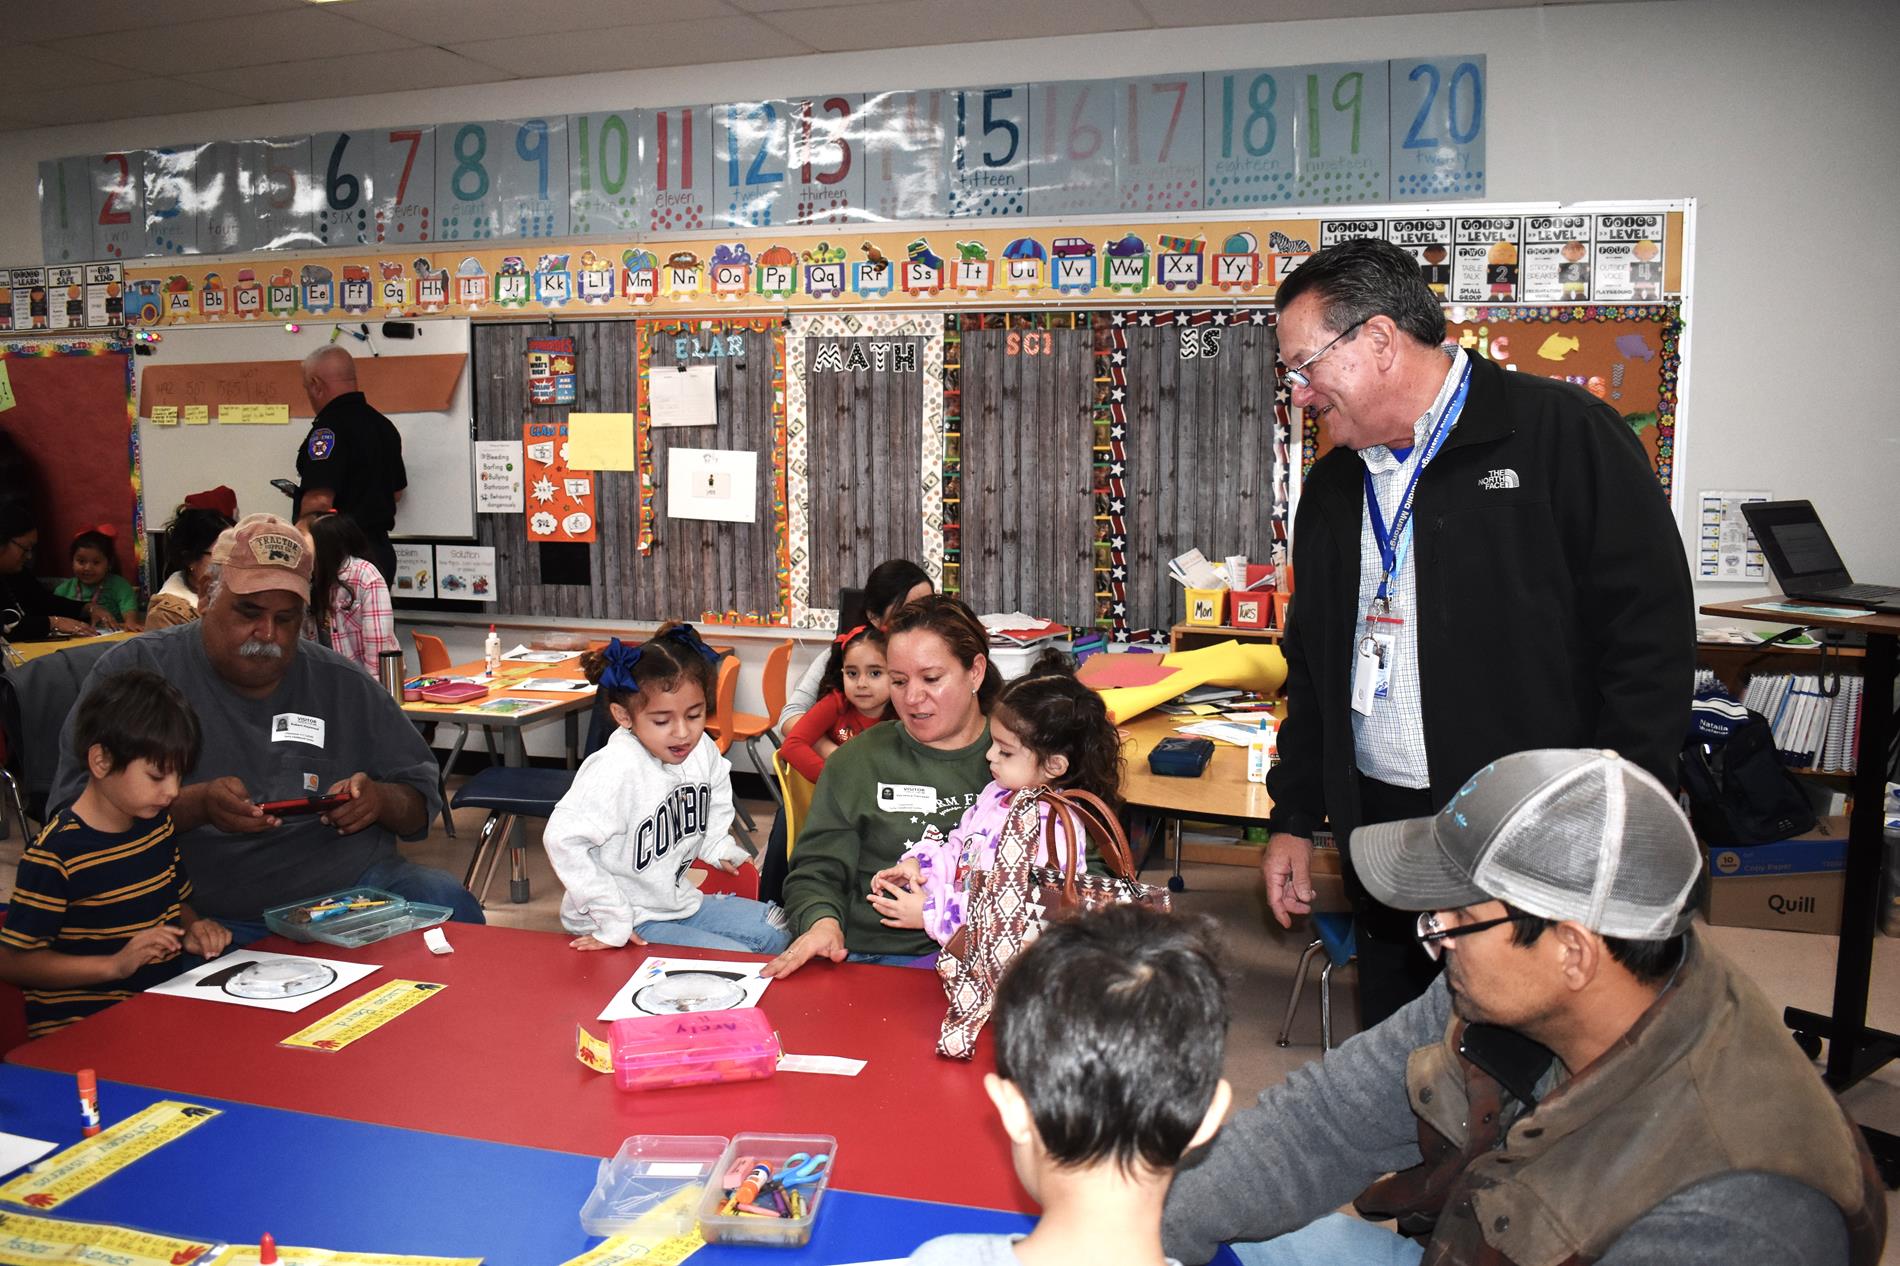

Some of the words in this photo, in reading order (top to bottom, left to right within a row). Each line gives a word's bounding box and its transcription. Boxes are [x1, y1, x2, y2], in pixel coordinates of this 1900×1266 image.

[1403, 63, 1482, 149] 20
[1222, 73, 1277, 157] 18
[1307, 72, 1363, 157] 19
[957, 89, 1019, 169] 15
[1045, 86, 1104, 160] 16
[1129, 82, 1187, 164] 17
[728, 103, 783, 186] 12
[800, 98, 851, 184] 13
[579, 115, 629, 195] 10
[657, 111, 692, 190] 11
[390, 130, 421, 205] 7
[452, 124, 490, 200] 8
[516, 119, 548, 200] 9
[326, 133, 359, 210] 6
[960, 173, 1014, 187] fifteen
[99, 154, 131, 224] 2
[800, 187, 847, 200] thirteen
[656, 193, 695, 208] eleven
[331, 211, 353, 224] six
[389, 204, 421, 217] even
[1401, 232, 1438, 243] LEVEL
[1467, 231, 1506, 242] LEVEL
[1538, 230, 1577, 240] LEVEL
[1610, 229, 1649, 240] LEVEL
[1459, 249, 1486, 257] TWO
[1599, 246, 1630, 254] FOUR
[912, 264, 931, 280] Ss
[962, 262, 981, 278] Tt
[1010, 261, 1034, 278] Uu
[1061, 260, 1084, 277] Vv
[1111, 259, 1143, 276] Ww
[1168, 256, 1193, 273] Xx
[1222, 257, 1246, 281] Yy
[1462, 264, 1483, 272] TABLE
[1638, 263, 1651, 281] 4
[57, 277, 74, 285] SAFE
[95, 274, 114, 282] KIND
[589, 271, 604, 287] Ll
[627, 271, 652, 287] Mm
[673, 270, 696, 284] Nn
[718, 268, 742, 283] Oo
[766, 267, 786, 289] Pp
[812, 267, 838, 288] Qq
[861, 265, 882, 281] Rr
[1495, 266, 1508, 282] 2
[1568, 265, 1580, 281] 3
[18, 279, 39, 287] LEARN
[349, 284, 363, 298] Ff
[421, 281, 442, 296] Hh
[467, 279, 479, 293] Ii
[504, 278, 520, 297] Jj
[545, 275, 564, 291] Kk
[205, 292, 222, 306] Bb
[239, 292, 257, 305] Cc
[274, 288, 292, 302] Dd
[310, 284, 326, 299] Ee
[384, 283, 403, 303] Gg
[171, 294, 189, 308] Aa
[675, 334, 746, 360] ELAR
[1006, 332, 1053, 356] SCI
[1179, 328, 1221, 359] SS
[813, 342, 917, 373] MATH
[1478, 477, 1505, 486] NORTH
[255, 535, 299, 551] TRACTOR
[396, 549, 418, 557] oblem
[450, 550, 481, 559] Solution
[1195, 601, 1212, 618] Mon
[1239, 603, 1256, 620] Tues
[1767, 863, 1792, 871] Paper
[1768, 894, 1815, 914] Quill
